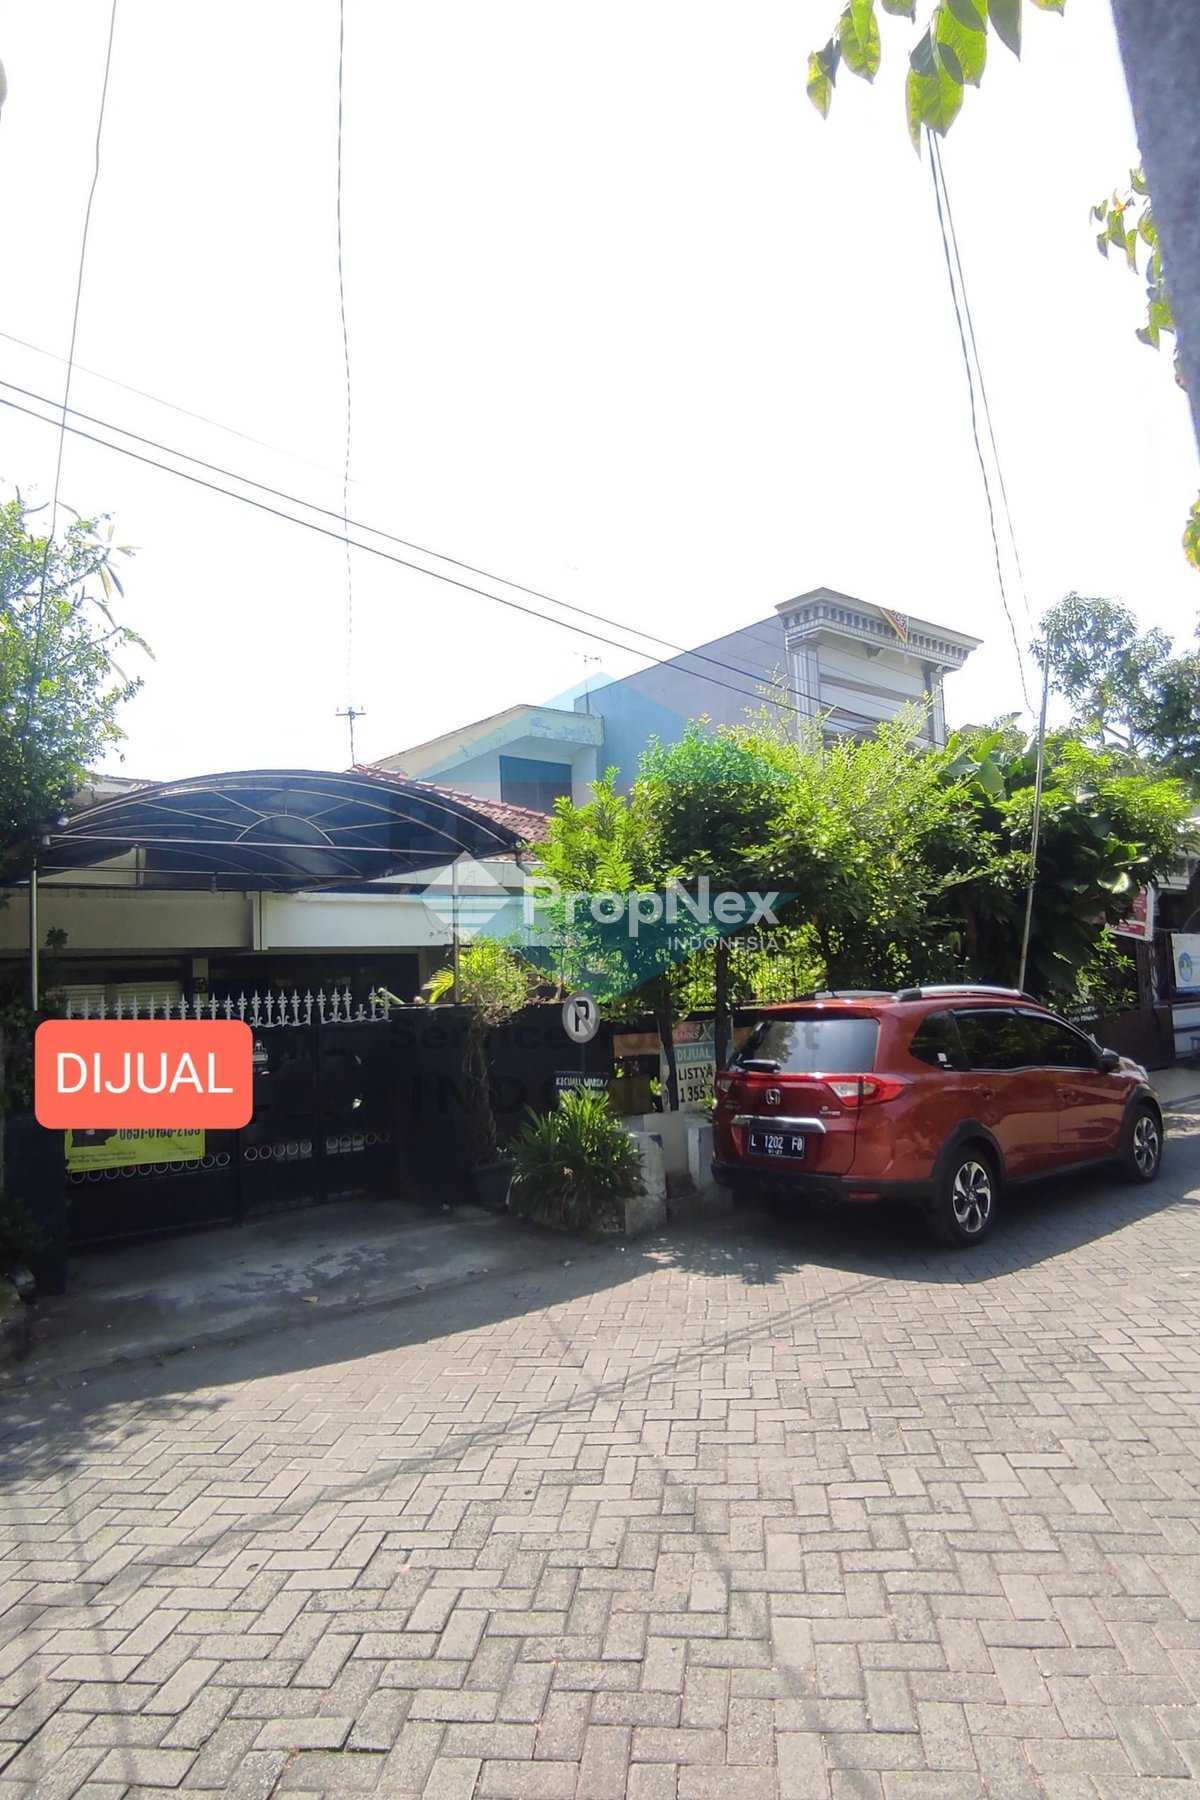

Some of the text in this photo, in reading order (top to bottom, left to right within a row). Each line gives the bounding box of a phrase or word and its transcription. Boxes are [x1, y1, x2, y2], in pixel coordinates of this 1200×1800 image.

[676, 1047, 712, 1062] DIJUAL
[751, 1134, 757, 1147] L
[765, 1135, 784, 1149] 1202
